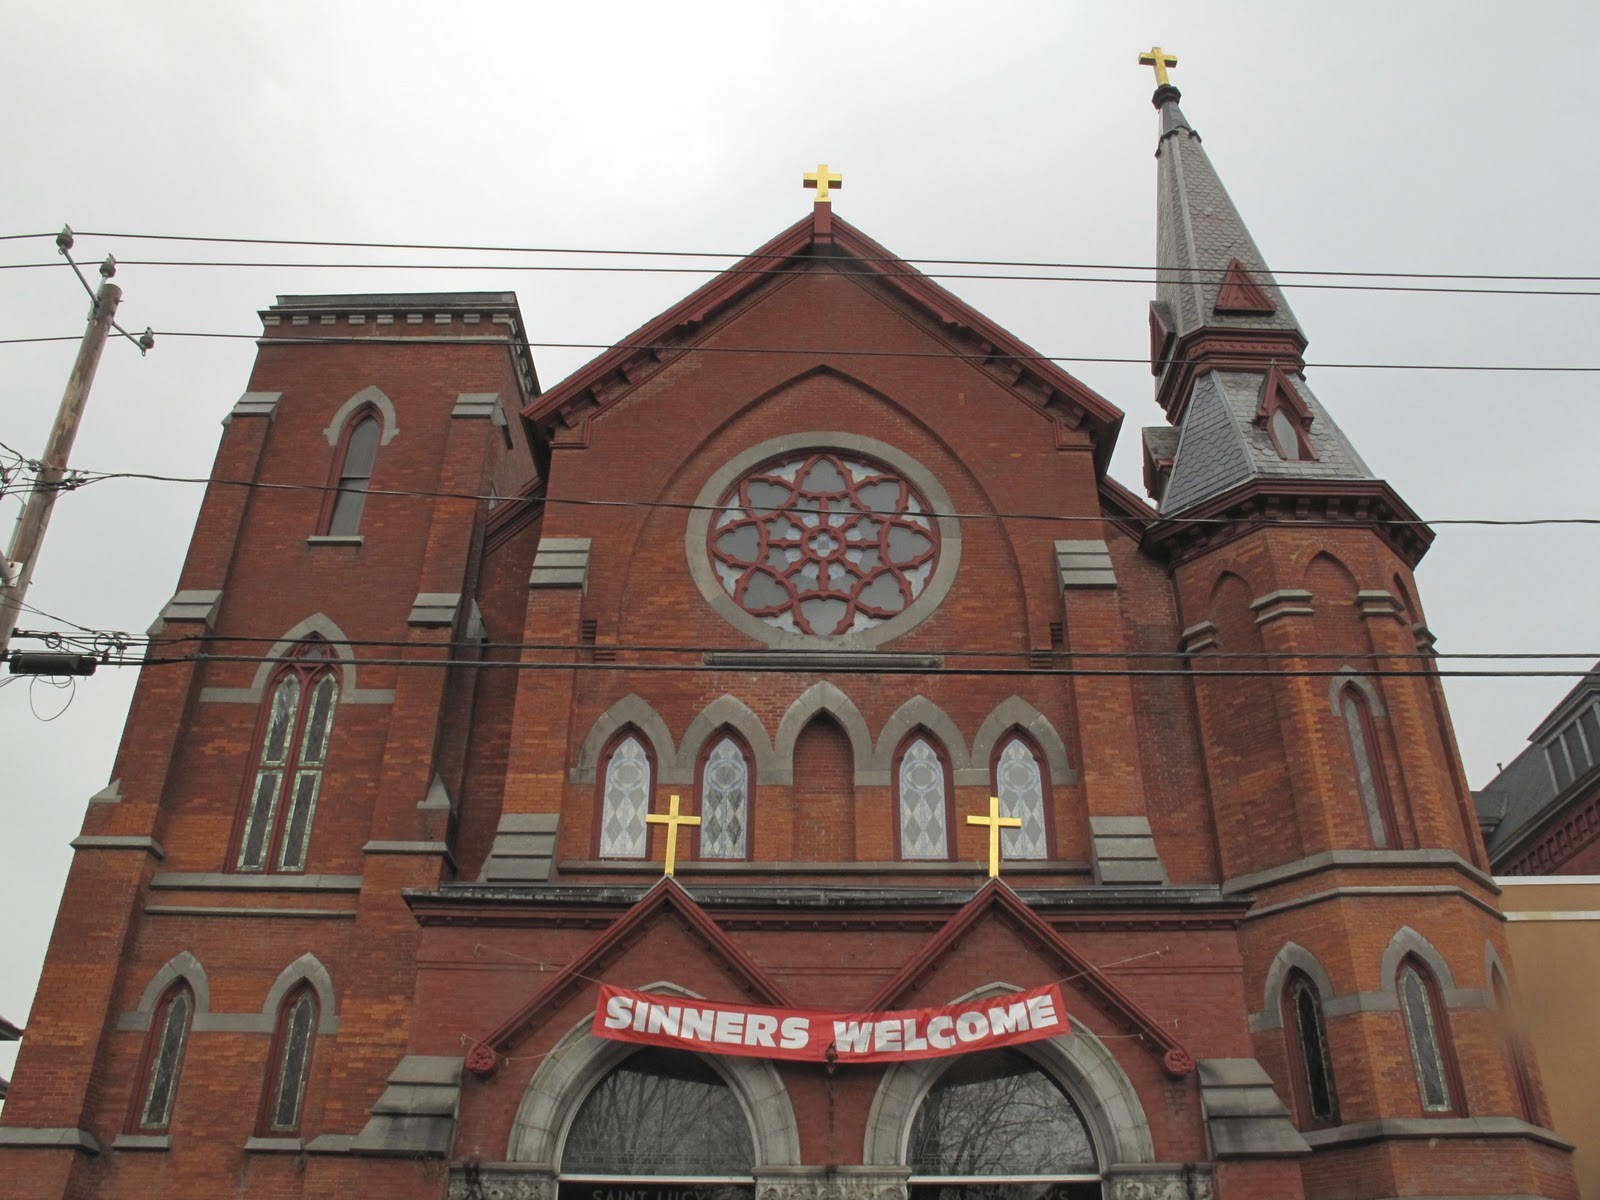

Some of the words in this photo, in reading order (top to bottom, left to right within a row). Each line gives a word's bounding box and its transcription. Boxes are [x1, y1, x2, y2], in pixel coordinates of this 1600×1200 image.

[604, 995, 810, 1050] SINNERS
[832, 993, 1059, 1054] WELCOME
[592, 1190, 648, 1200] SAINT
